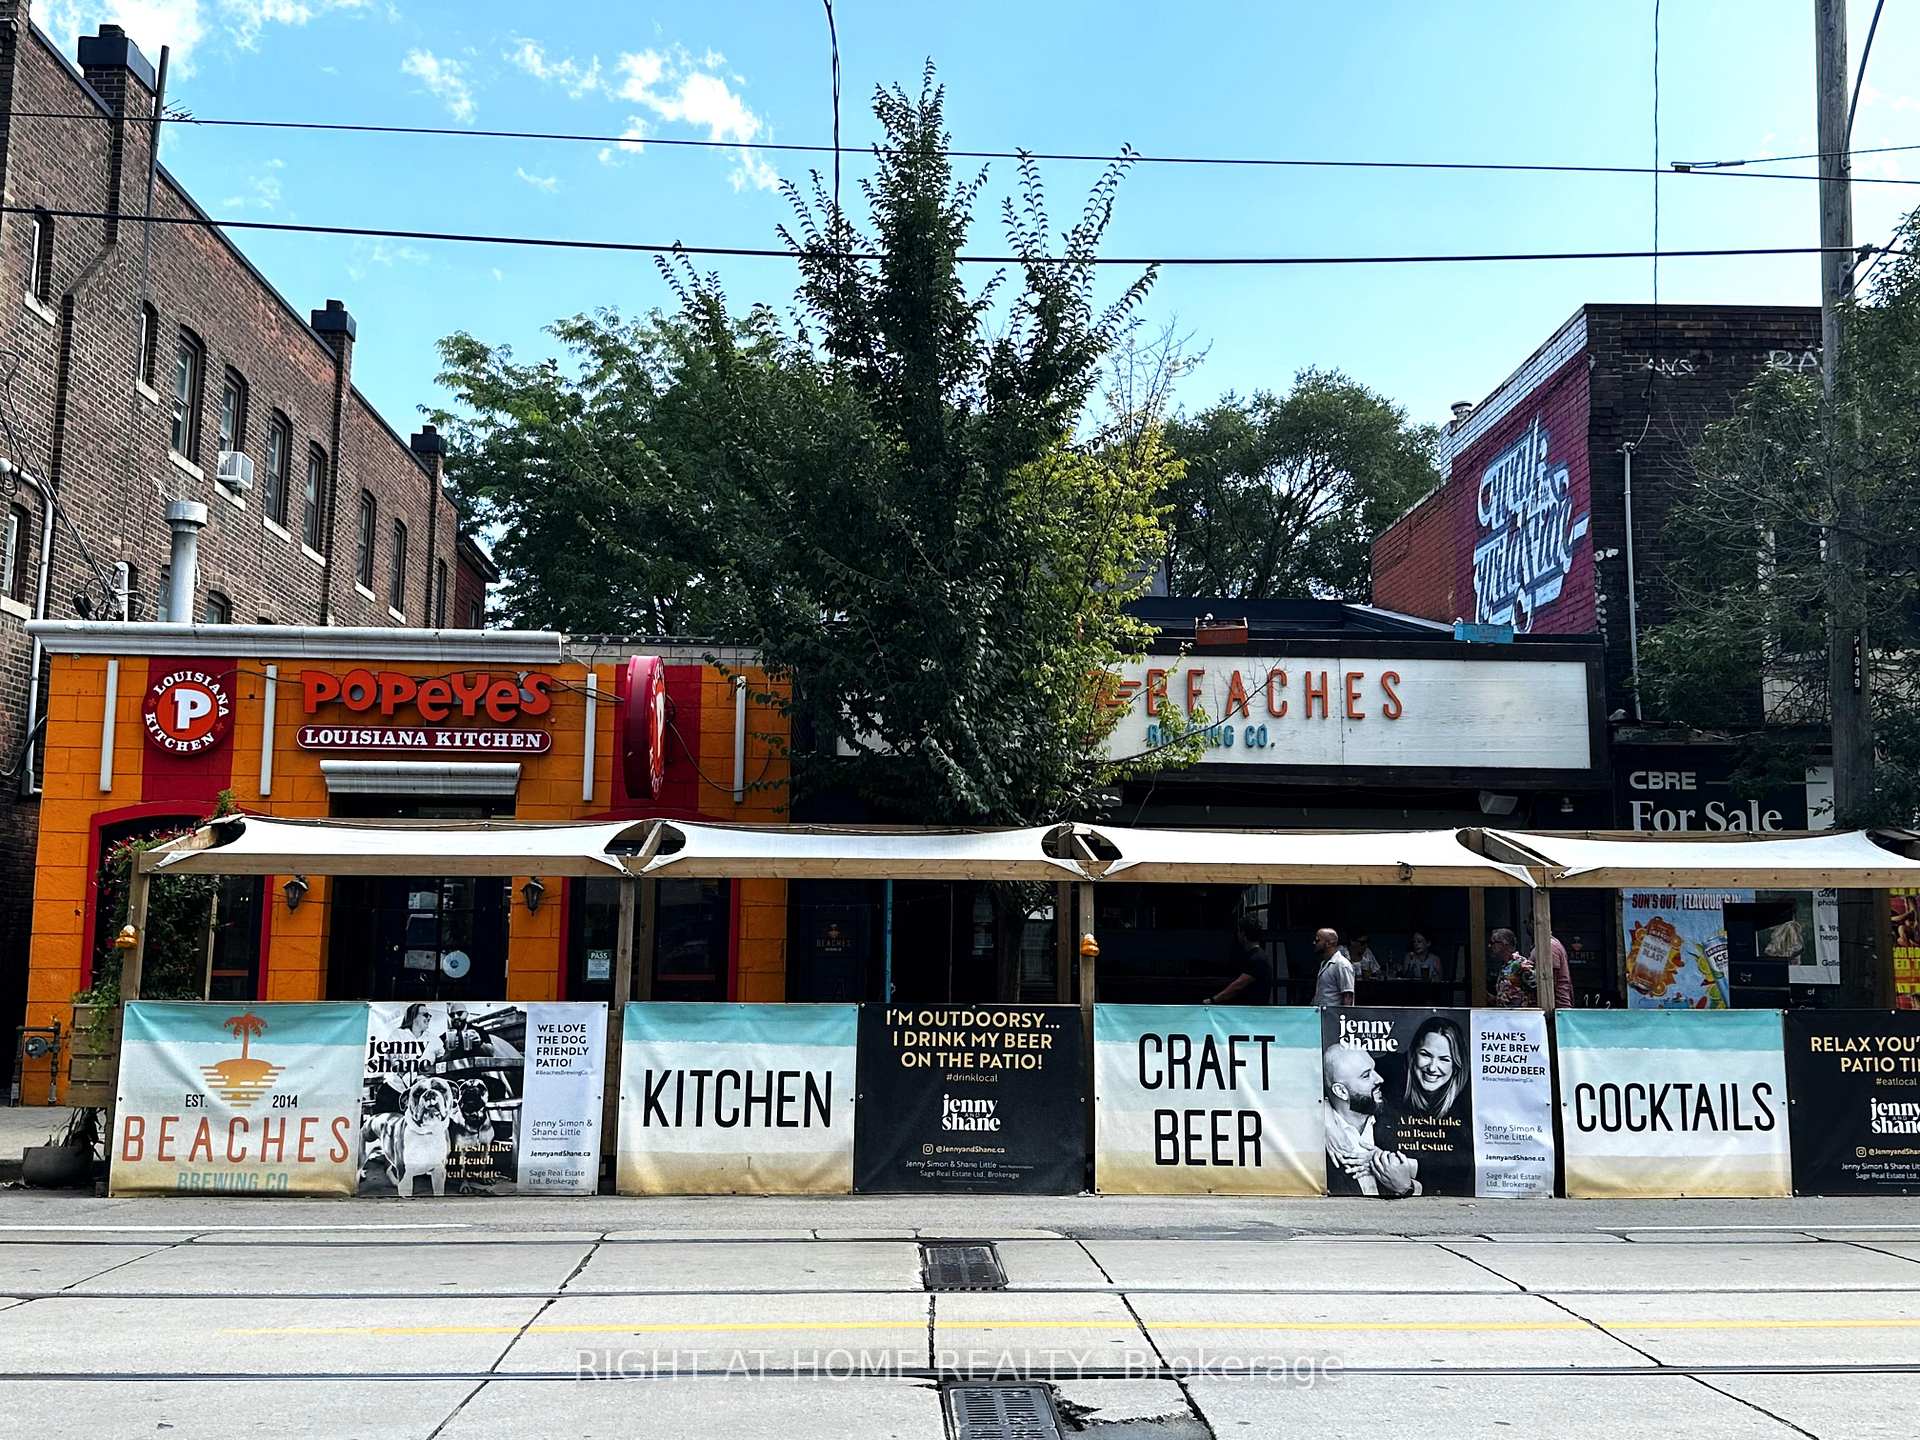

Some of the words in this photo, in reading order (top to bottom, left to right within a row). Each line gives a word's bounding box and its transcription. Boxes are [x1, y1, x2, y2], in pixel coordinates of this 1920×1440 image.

[153, 671, 230, 717] LOUISIANA
[174, 688, 212, 729] P
[145, 711, 215, 752] KITCHEN
[304, 728, 428, 746] LOUISIANA
[435, 730, 542, 748] KITCHEN
[1244, 723, 1276, 748] CO.
[1629, 771, 1697, 790] CBRE
[1629, 800, 1696, 832] For
[1704, 799, 1783, 832] Sale
[591, 952, 608, 960] PASS
[886, 1009, 913, 1026] I'M
[918, 1011, 1061, 1029] OUTDOORSY...
[1339, 1014, 1395, 1039] jenny
[537, 1024, 555, 1033] WE
[557, 1023, 587, 1033] LOVE
[1480, 1031, 1527, 1041] SHANE'S
[368, 1035, 430, 1060] jenny
[536, 1035, 558, 1044] THE
[561, 1035, 587, 1044] DOG
[893, 1030, 898, 1046] I
[904, 1031, 966, 1047] DRINK
[971, 1032, 1000, 1048] MY
[1004, 1033, 1053, 1050] BEER
[1339, 1034, 1399, 1052] shane
[1481, 1042, 1507, 1052] FAVE
[1508, 1043, 1540, 1053] BREW
[1810, 1036, 1872, 1052] RELAX
[536, 1046, 590, 1056] FRIENDLY
[1481, 1053, 1491, 1063] IS
[1493, 1054, 1528, 1064] BEACH
[367, 1055, 432, 1073] shane
[536, 1058, 572, 1068] PATIO!
[901, 1052, 931, 1068] ON
[936, 1052, 974, 1068] THE
[979, 1053, 1043, 1070] PATIO!
[1138, 1033, 1276, 1091] CRAFT
[1840, 1057, 1896, 1073] PATIO
[1898, 1057, 1920, 1073] TI
[946, 1073, 999, 1083] #drinklocal
[1482, 1065, 1520, 1075] BOUND
[1520, 1066, 1546, 1076] BEER
[1875, 1077, 1918, 1086] #eatlocal
[185, 1094, 208, 1108] EST.
[272, 1095, 298, 1109] 2014
[642, 1068, 833, 1128] KITCHEN
[942, 1093, 998, 1117] jenny
[1574, 1081, 1776, 1133] COCKTAILS
[532, 1120, 557, 1128] Jenny
[559, 1119, 585, 1127] Simon
[586, 1119, 593, 1127] &
[941, 1113, 1001, 1131] shane
[1483, 1123, 1508, 1133] Jenny
[1509, 1124, 1535, 1132] Simon
[1536, 1125, 1543, 1133] &
[1871, 1116, 1920, 1134] shan
[121, 1115, 351, 1163] BEACHES
[531, 1128, 558, 1136] Shane
[560, 1128, 581, 1136] Little
[1154, 1109, 1263, 1167] BEER
[1397, 1130, 1411, 1138] on
[1413, 1128, 1446, 1138] Beach
[1483, 1132, 1510, 1140] Shane
[1511, 1133, 1533, 1141] Little
[1397, 1140, 1420, 1150] real
[905, 1160, 925, 1168] Jenny
[926, 1160, 949, 1168] Simon
[950, 1160, 956, 1168] &
[176, 1172, 259, 1191] BREWING
[528, 1169, 546, 1177] Sage
[547, 1169, 563, 1177] Real
[1486, 1172, 1502, 1180] Sage
[1503, 1172, 1519, 1180] Real
